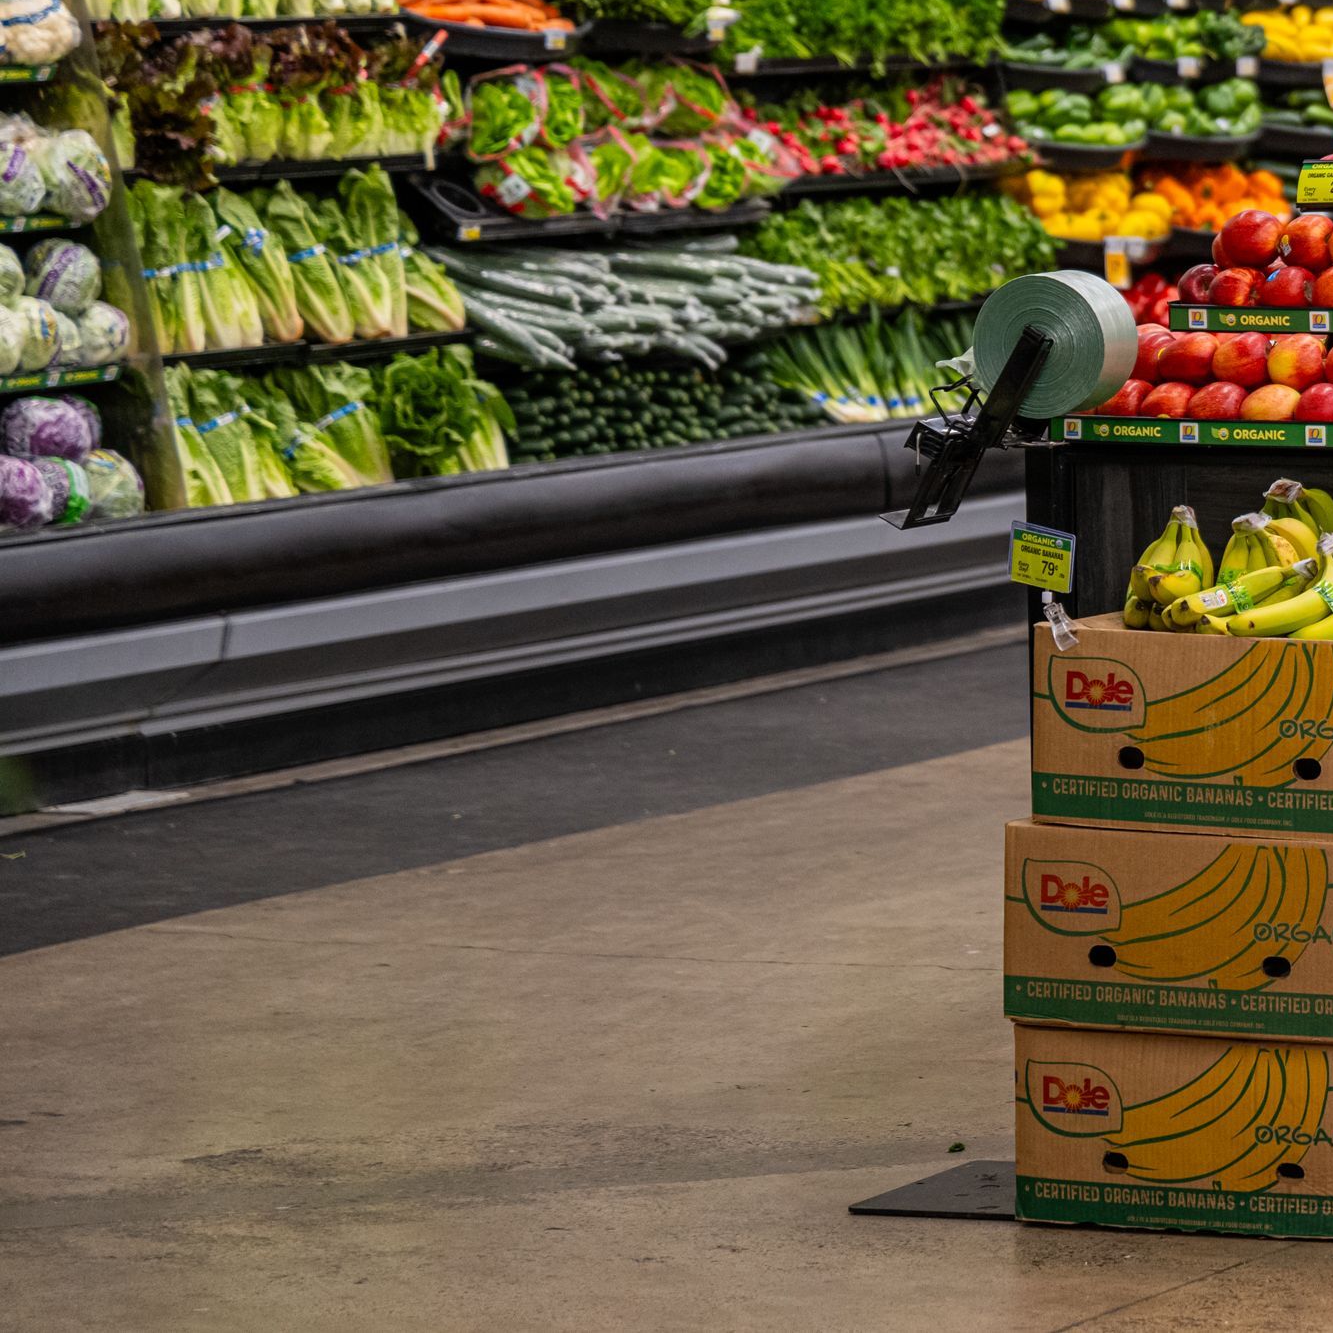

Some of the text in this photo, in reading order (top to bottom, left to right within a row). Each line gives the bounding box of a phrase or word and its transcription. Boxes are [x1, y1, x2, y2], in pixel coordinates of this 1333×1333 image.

[1240, 314, 1290, 326] ORGANIC
[1113, 425, 1161, 437] ORGANIC
[1234, 429, 1285, 440] ORGANIC
[1020, 544, 1064, 561] ORGANIC BANANAS
[1022, 533, 1056, 547] ORGANIC
[1065, 670, 1134, 706] Dole
[1053, 778, 1118, 799] CERTIFIED
[1122, 783, 1182, 802] ORGANIC
[1187, 786, 1254, 807] BANANAS
[1041, 874, 1109, 910] Dole
[1027, 981, 1092, 1001] CERTIFIED
[1096, 986, 1156, 1006] ORGANIC
[1160, 989, 1227, 1011] BANANAS
[1241, 995, 1311, 1014] CERTIFIED
[1043, 1076, 1110, 1112] Dole
[1035, 1182, 1100, 1202] CERTIFIED
[1104, 1187, 1164, 1207] ORGANIC
[1168, 1190, 1236, 1211] BANANAS
[1249, 1197, 1319, 1216] CERTIFIED
